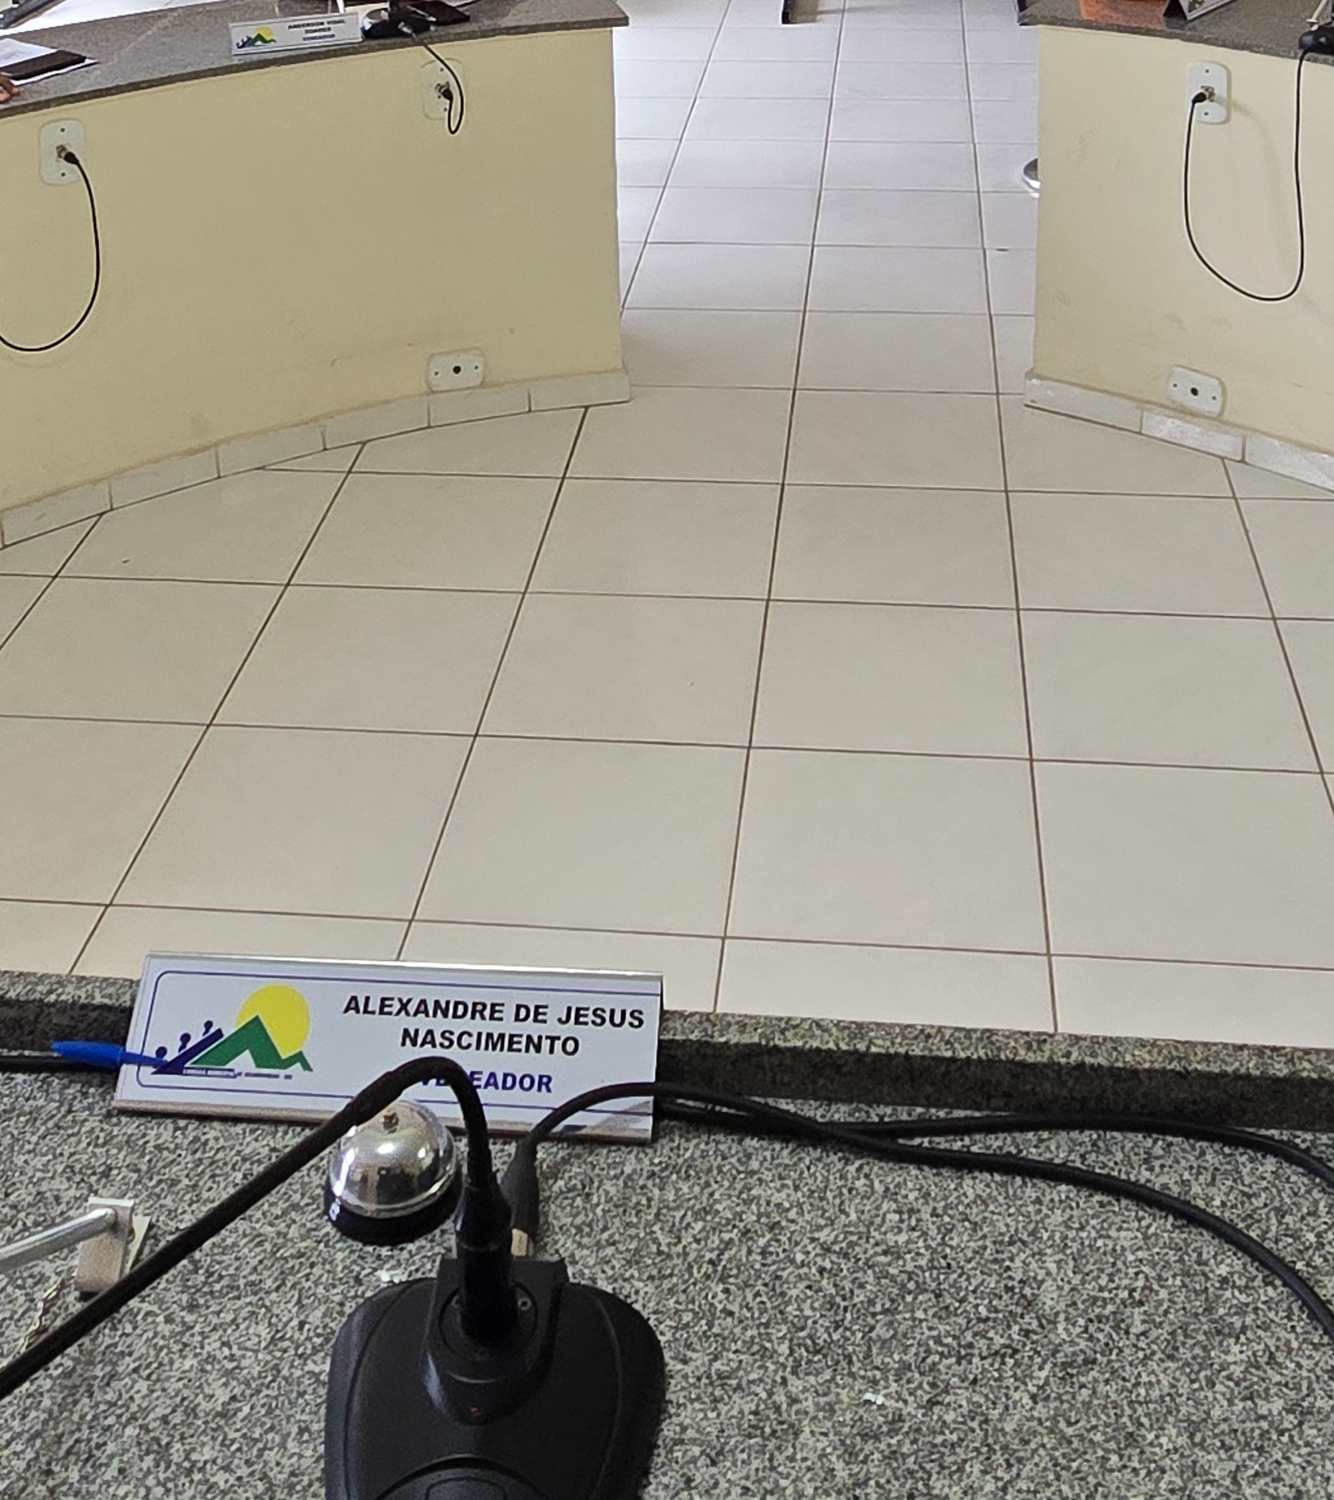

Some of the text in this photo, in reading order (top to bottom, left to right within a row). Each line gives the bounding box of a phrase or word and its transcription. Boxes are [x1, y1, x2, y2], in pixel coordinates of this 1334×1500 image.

[343, 995, 645, 1029] ALEXANDRE DE JESUS
[400, 1027, 580, 1056] NASCIMENTO
